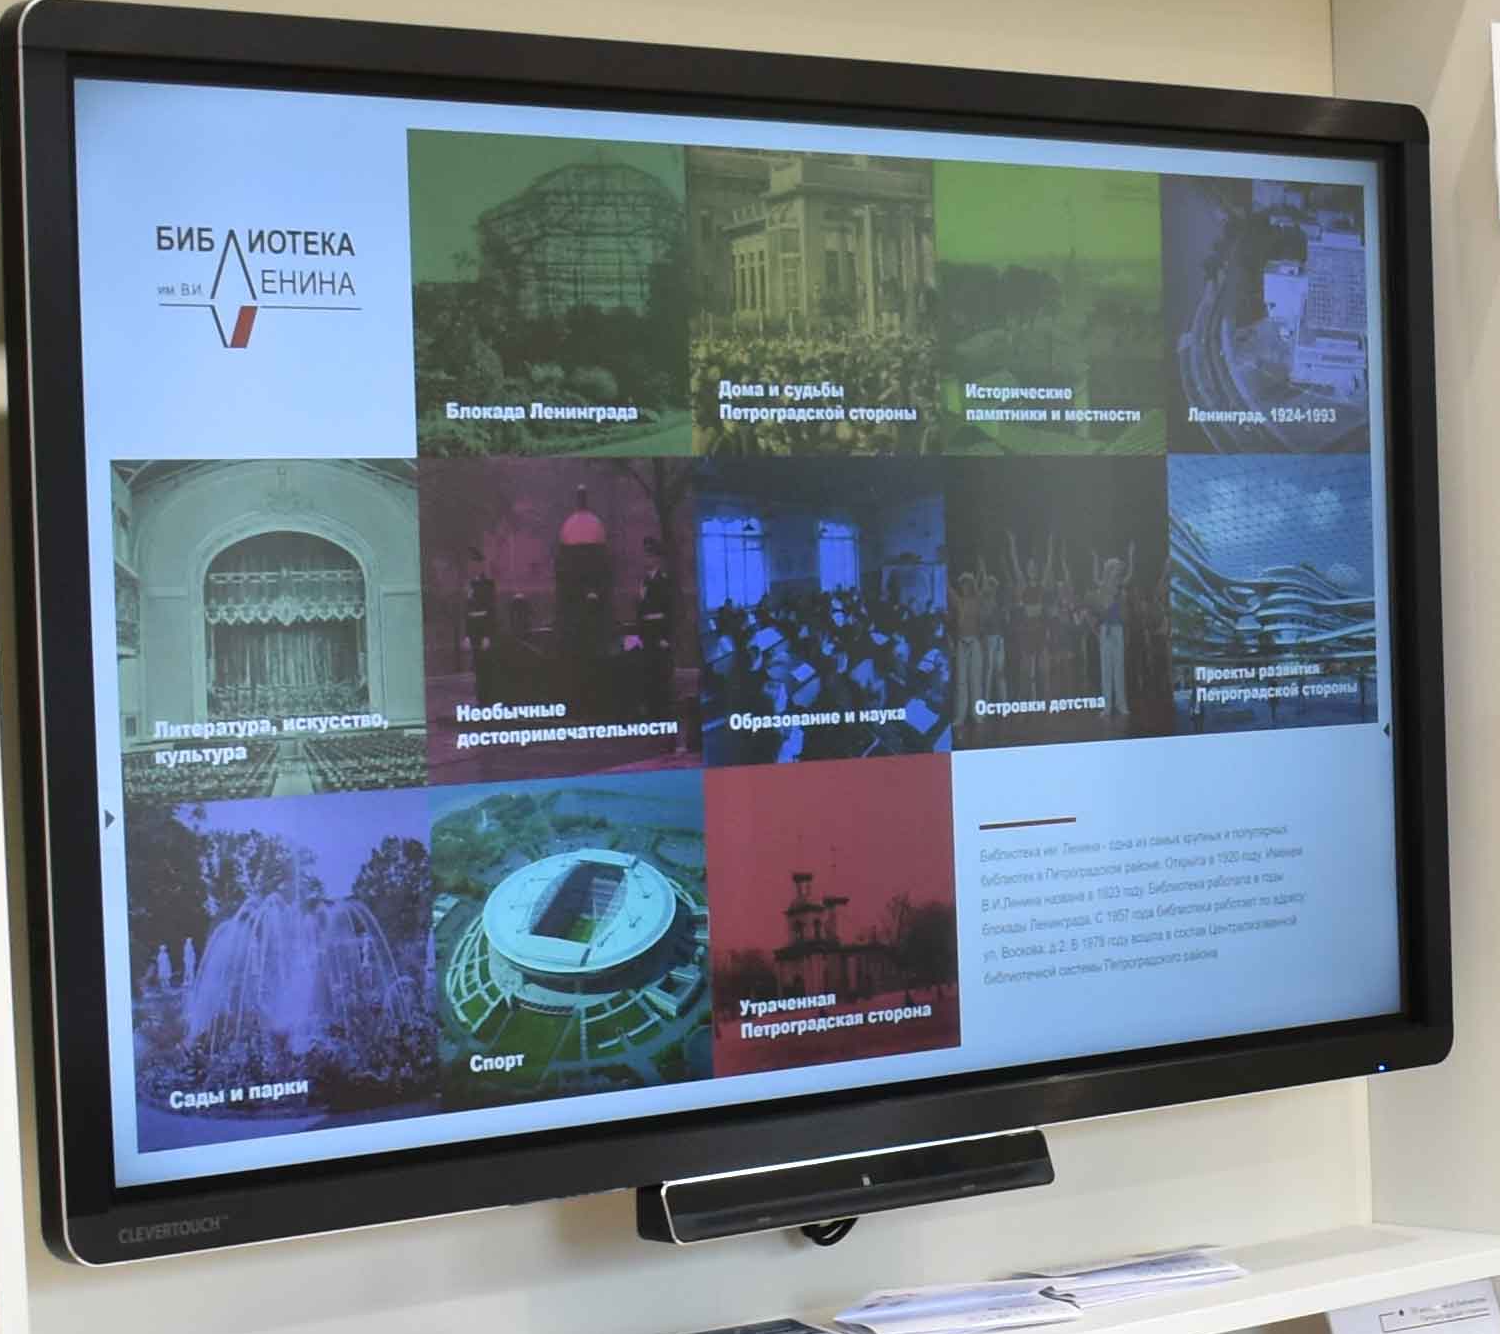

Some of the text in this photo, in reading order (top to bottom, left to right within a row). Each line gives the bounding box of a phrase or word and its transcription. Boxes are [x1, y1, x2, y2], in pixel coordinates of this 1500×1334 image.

[155, 225, 357, 259] БИБЛИОТЕКА
[718, 380, 844, 402] Дома и судьбы
[965, 383, 1073, 403] Исторические
[445, 401, 639, 424] Блокада Ленинграда
[719, 404, 918, 424] Петроградской стороны
[966, 406, 1141, 423] памятники и местности
[1195, 662, 1320, 685] Проекты развития
[1195, 680, 1359, 706] Петроградской стороны
[456, 701, 567, 724] Необычные
[729, 705, 907, 732] Образование и наука
[975, 694, 1106, 718] Островки детства
[153, 710, 390, 744] Литература, искусство,
[456, 718, 679, 750] достопримечательности
[153, 742, 248, 768] культура
[739, 990, 837, 1019] Утраченная
[740, 1001, 932, 1042] Петроградская сторона
[469, 1051, 526, 1076] Спорт
[169, 1078, 309, 1112] Сады и парки
